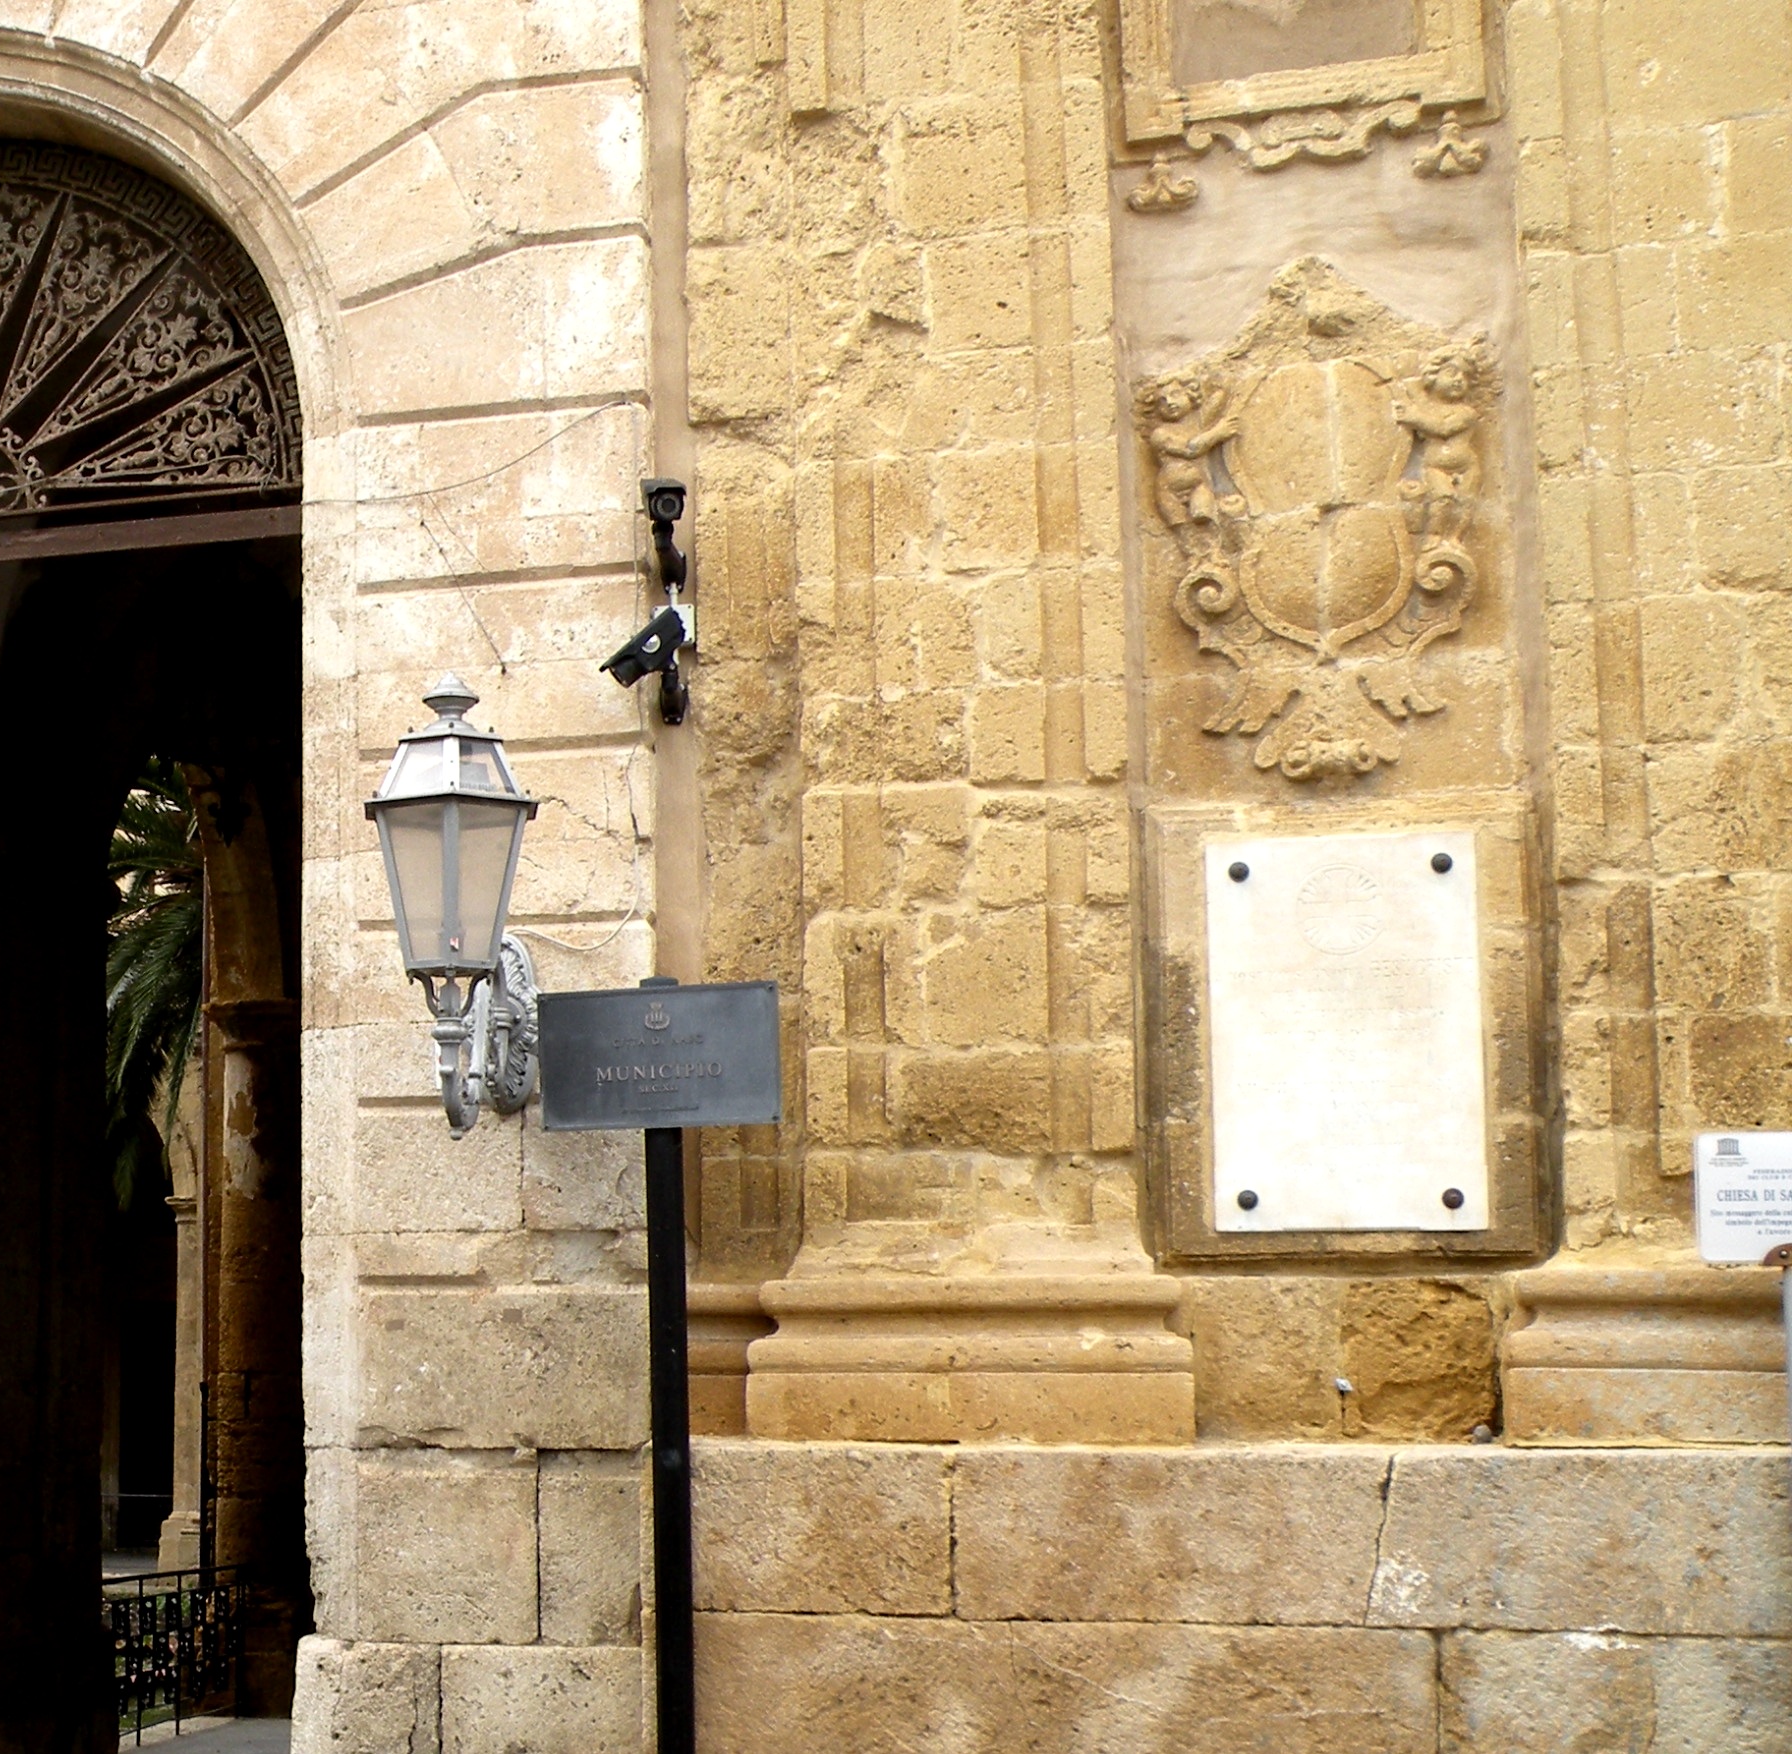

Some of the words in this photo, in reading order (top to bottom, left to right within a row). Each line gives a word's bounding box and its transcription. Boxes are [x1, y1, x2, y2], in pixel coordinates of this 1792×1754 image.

[596, 1062, 722, 1083] MUNICIPIO
[1716, 1189, 1758, 1202] CHIESA
[1764, 1189, 1775, 1201] DI
